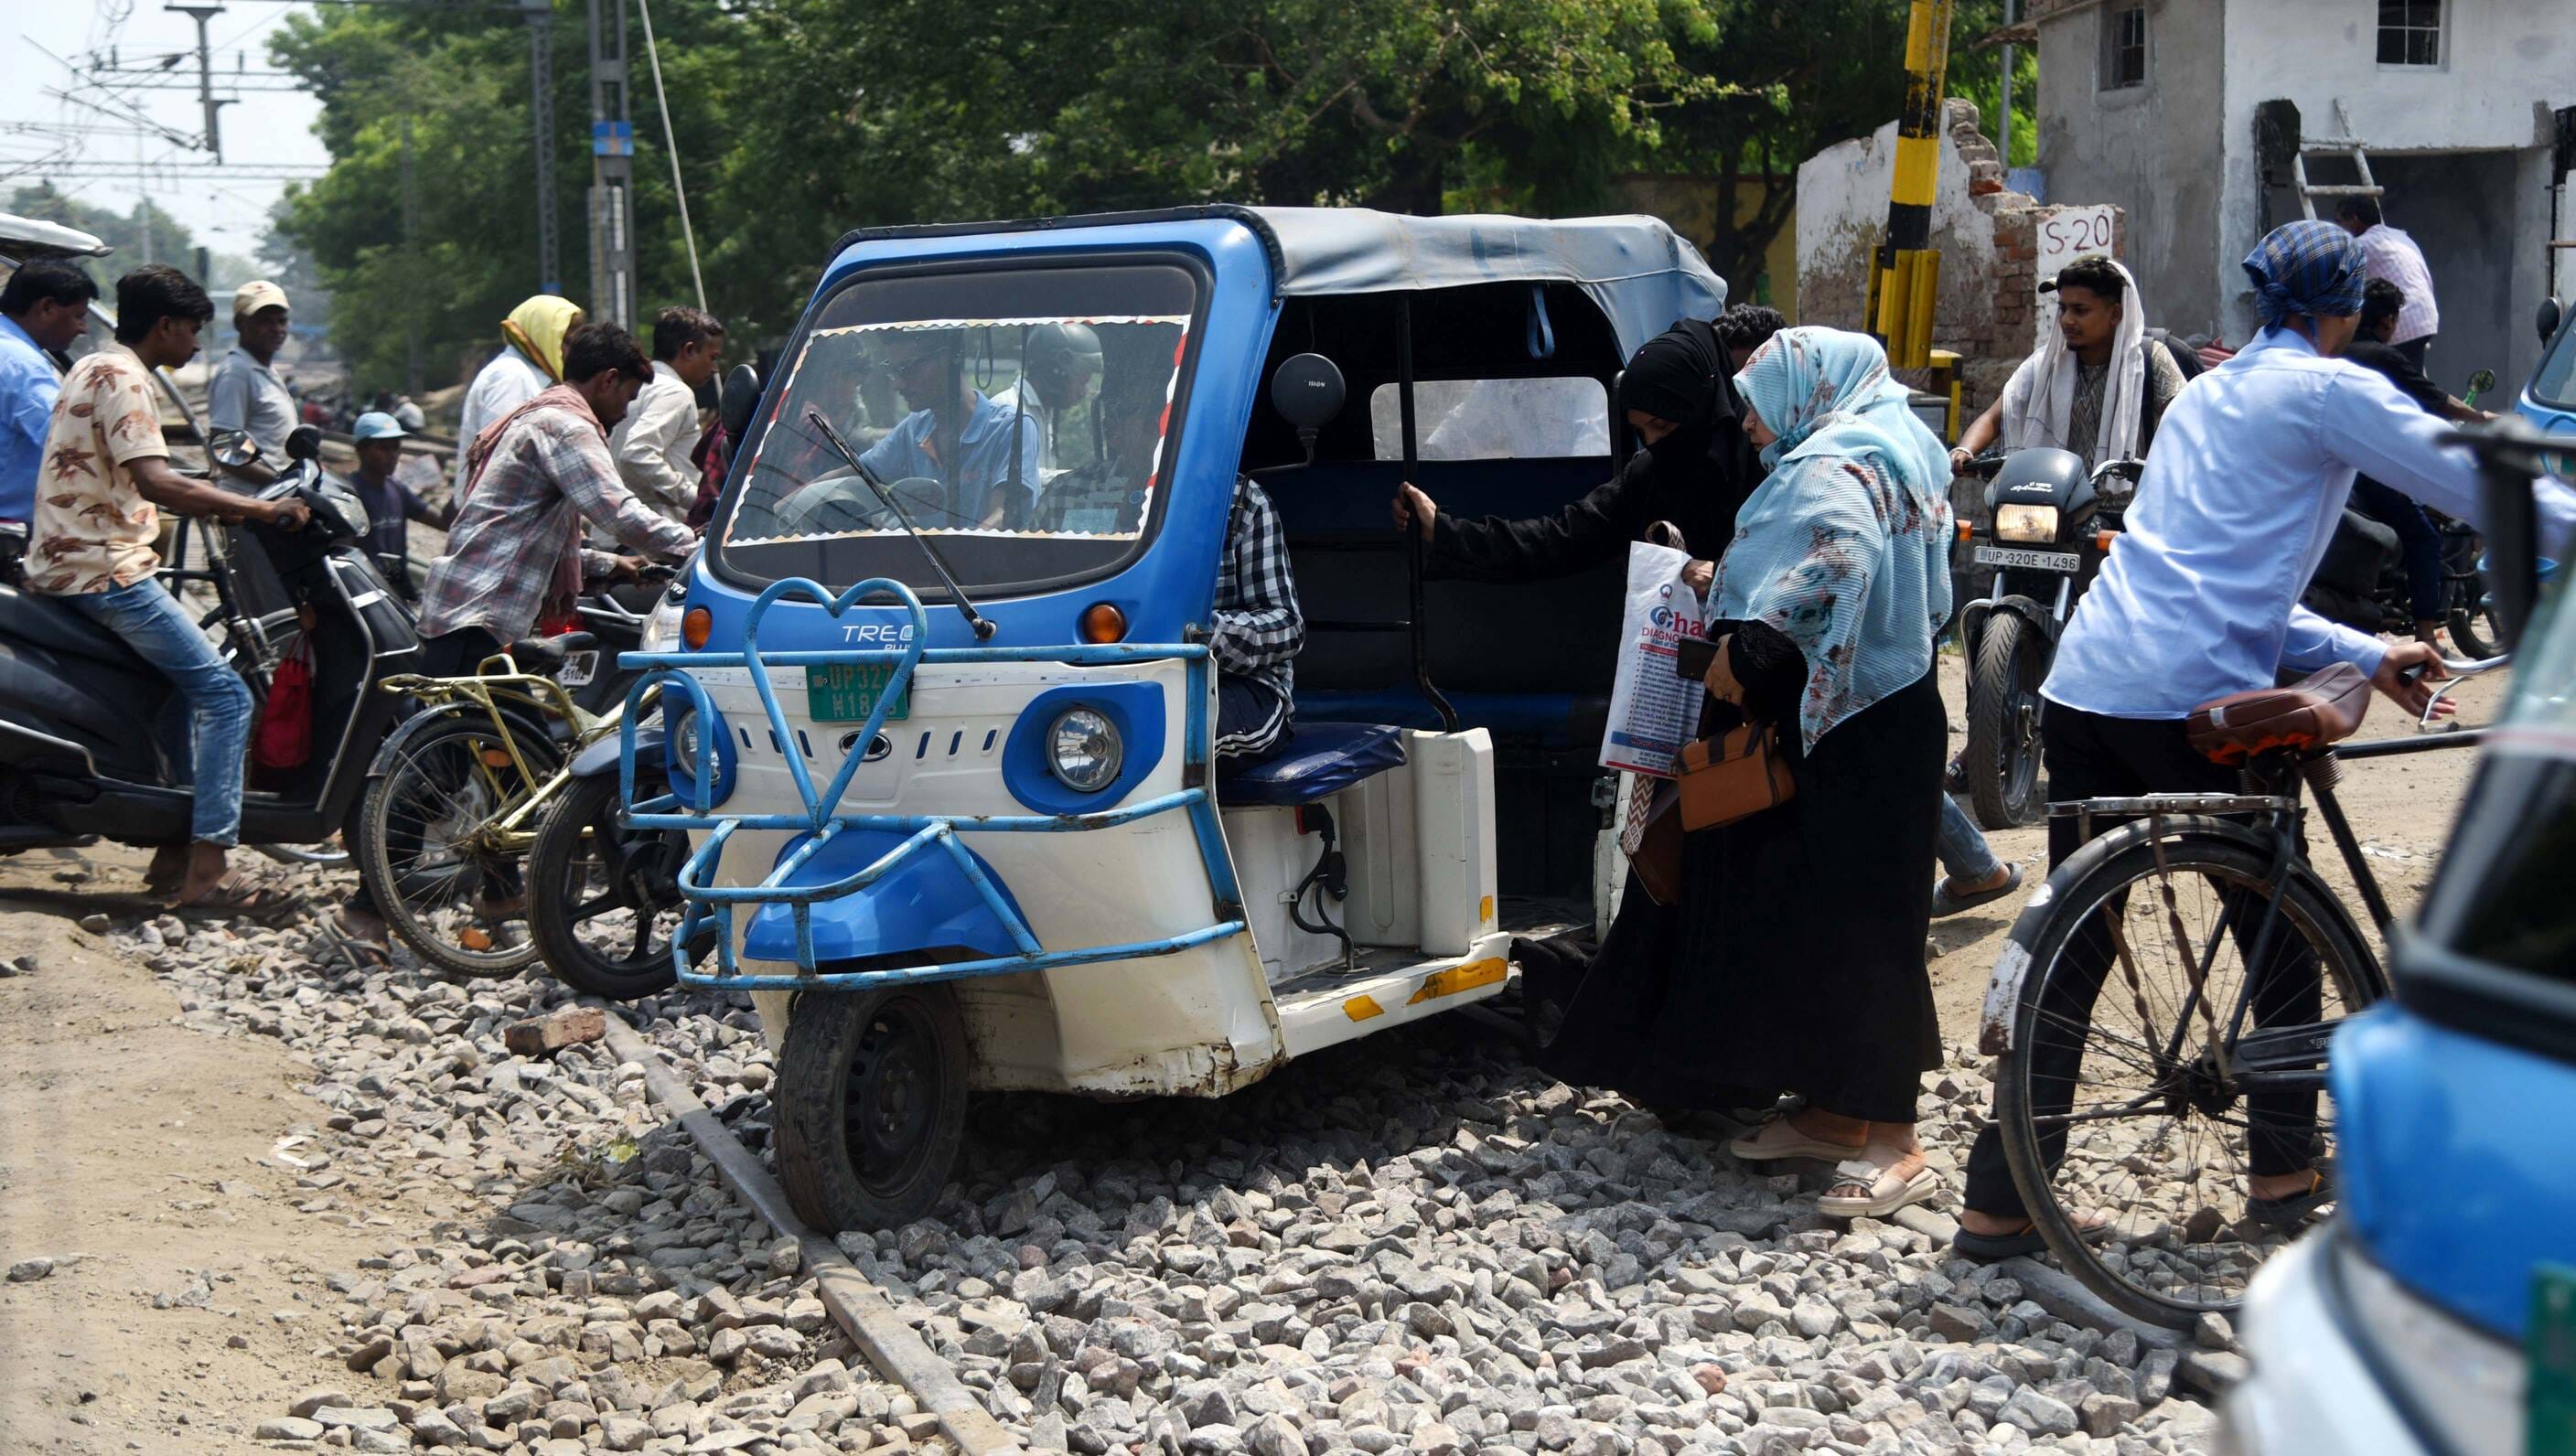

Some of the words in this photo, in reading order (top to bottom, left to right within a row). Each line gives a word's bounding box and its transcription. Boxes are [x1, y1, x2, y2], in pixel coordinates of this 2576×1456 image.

[2045, 214, 2109, 254] S-20
[2046, 556, 2077, 569] 1496
[1641, 626, 1685, 642] DIAGNO
